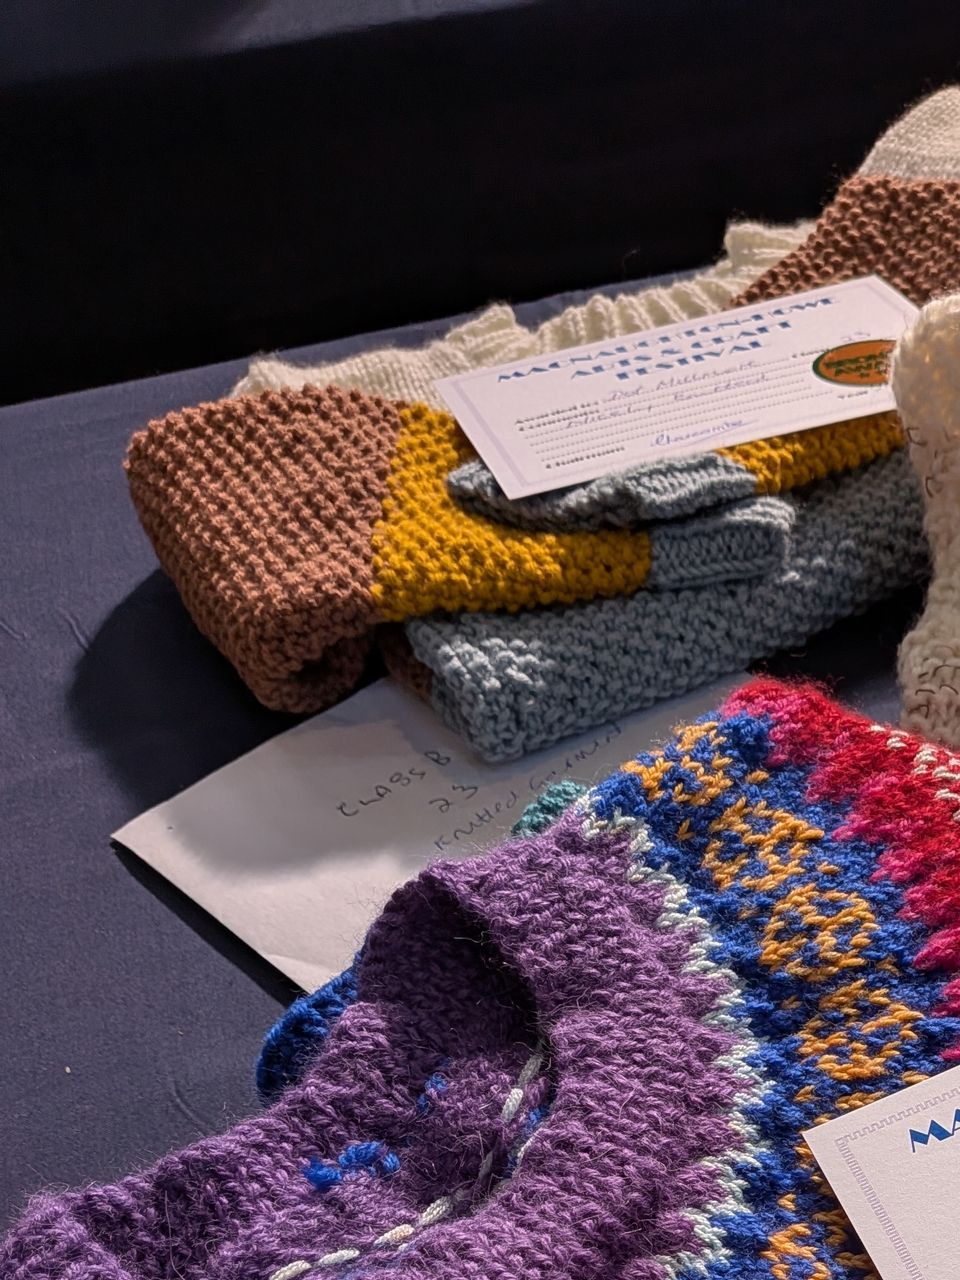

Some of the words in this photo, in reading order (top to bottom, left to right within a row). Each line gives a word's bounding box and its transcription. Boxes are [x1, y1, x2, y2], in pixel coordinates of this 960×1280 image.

[336, 767, 427, 817] CLASS
[423, 750, 452, 767] B
[428, 783, 480, 814] 23
